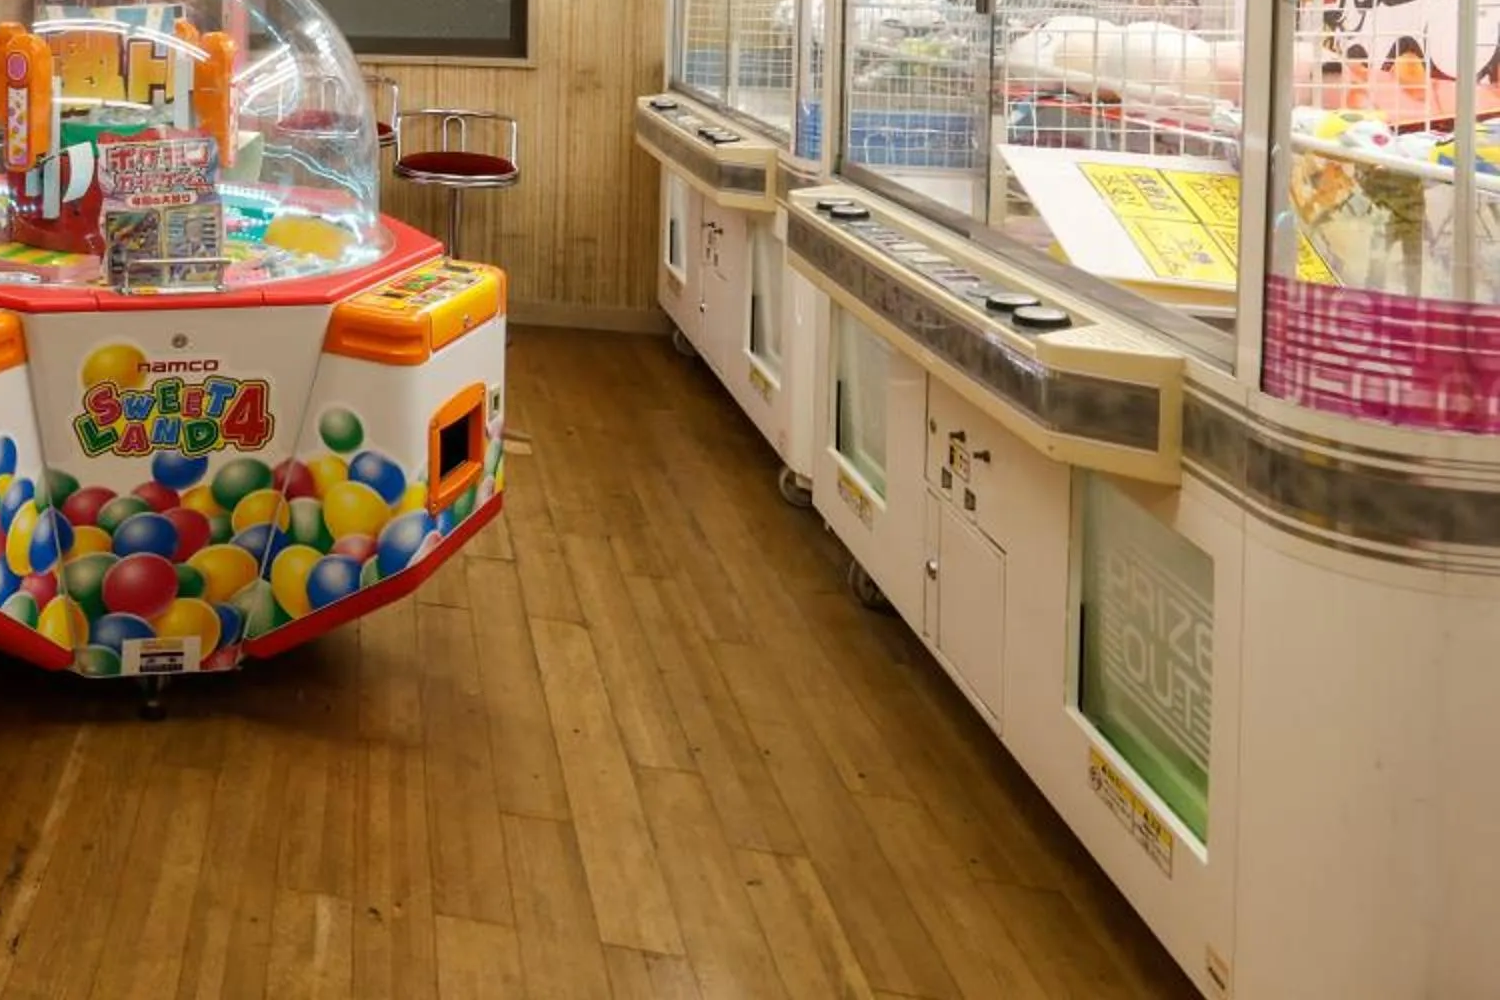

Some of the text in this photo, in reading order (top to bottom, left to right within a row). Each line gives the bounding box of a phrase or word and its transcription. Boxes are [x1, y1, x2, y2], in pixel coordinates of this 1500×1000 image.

[137, 359, 219, 373] namco
[77, 384, 269, 452] LAND 4
[86, 380, 238, 427] SWEET
